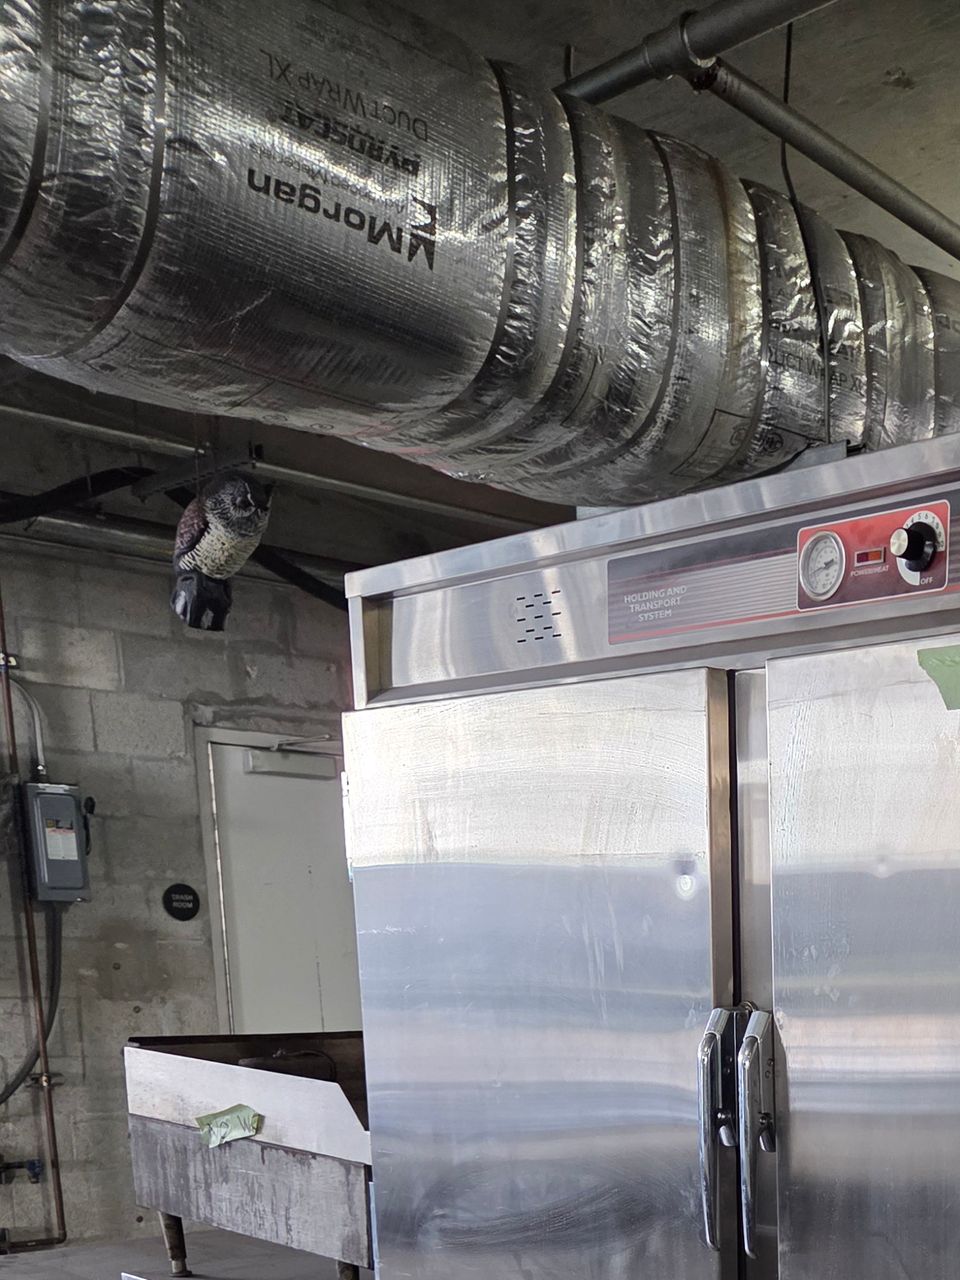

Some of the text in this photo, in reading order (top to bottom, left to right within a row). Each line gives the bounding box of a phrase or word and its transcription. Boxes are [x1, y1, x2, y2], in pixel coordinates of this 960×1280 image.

[259, 49, 291, 86] XL
[299, 71, 366, 118] WRAP
[248, 168, 403, 254] Morgan
[921, 577, 933, 585] OFF
[624, 585, 687, 604] HOLDING AND
[629, 596, 681, 613] TRANSPORT
[639, 609, 672, 622] SYSTEM
